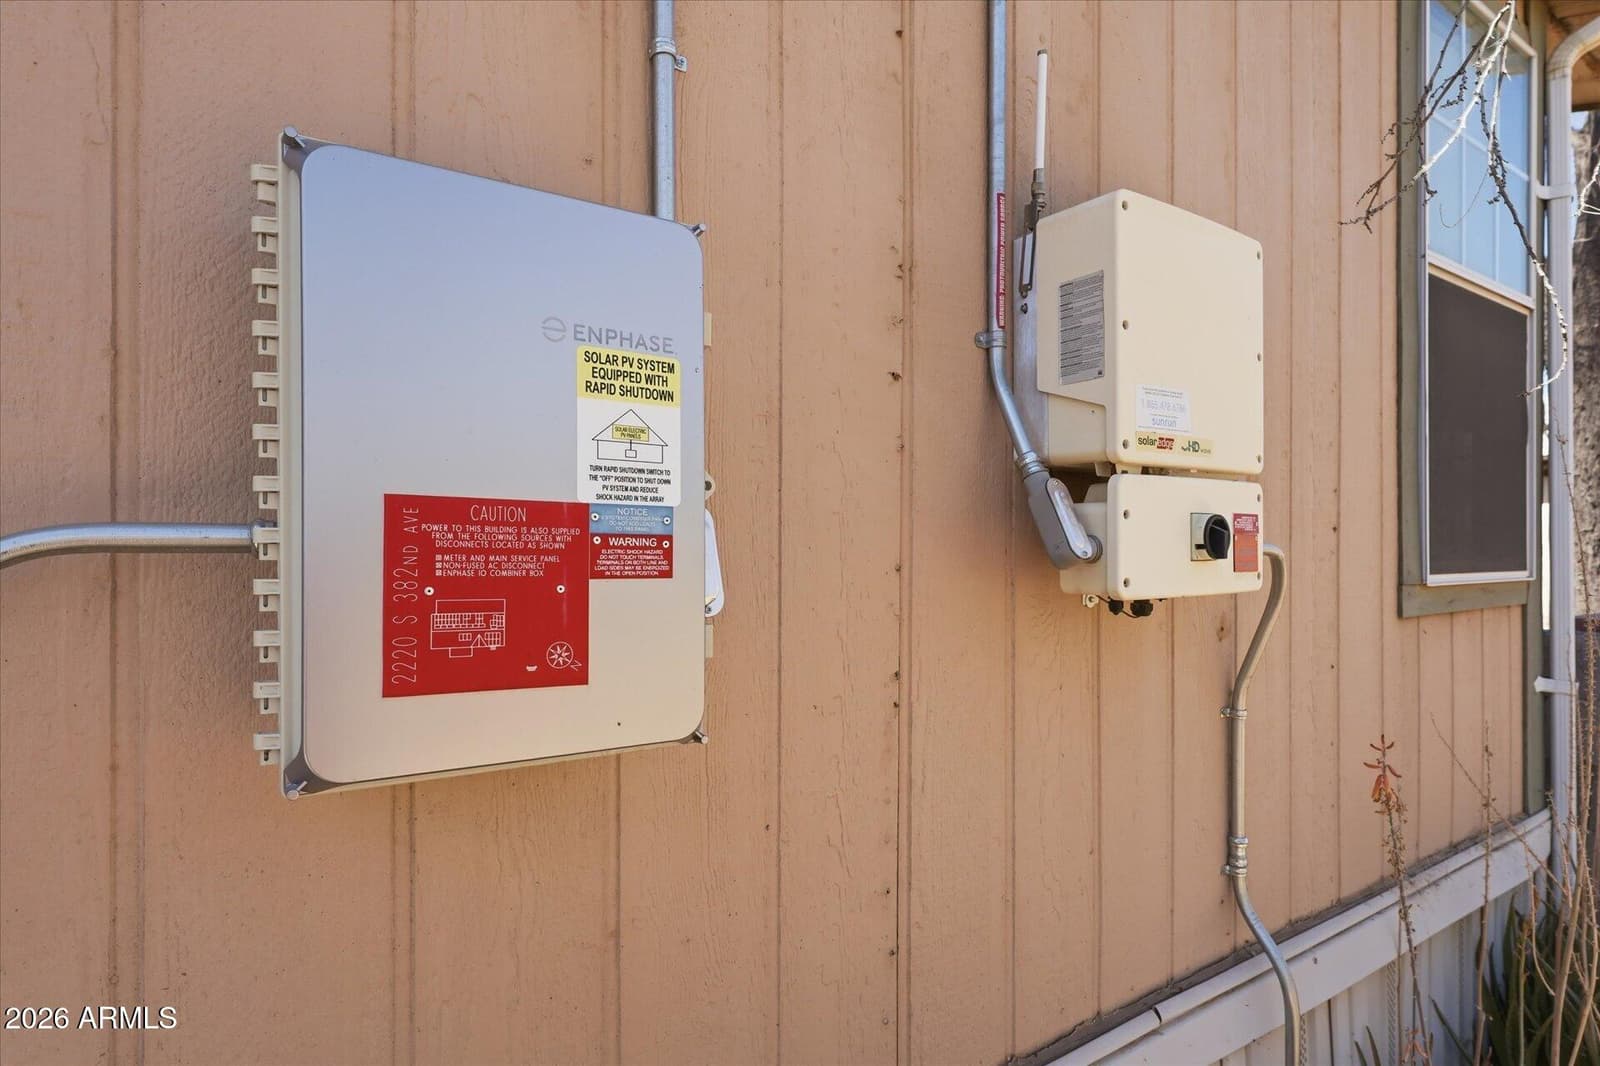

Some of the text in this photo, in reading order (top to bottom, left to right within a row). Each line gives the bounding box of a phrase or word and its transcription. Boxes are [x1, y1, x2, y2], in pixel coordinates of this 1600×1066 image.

[573, 324, 674, 354] ENPHASE
[584, 351, 674, 374] SOLAR PV SYSTEM
[592, 367, 668, 387] EQUIPPED WITH
[585, 381, 674, 402] RAPID SHUTDOWN
[470, 505, 526, 522] CAUTION
[617, 508, 648, 516] NOTICE
[608, 537, 657, 546] WARNING
[392, 506, 419, 684] 2220 S 382ND AVE
